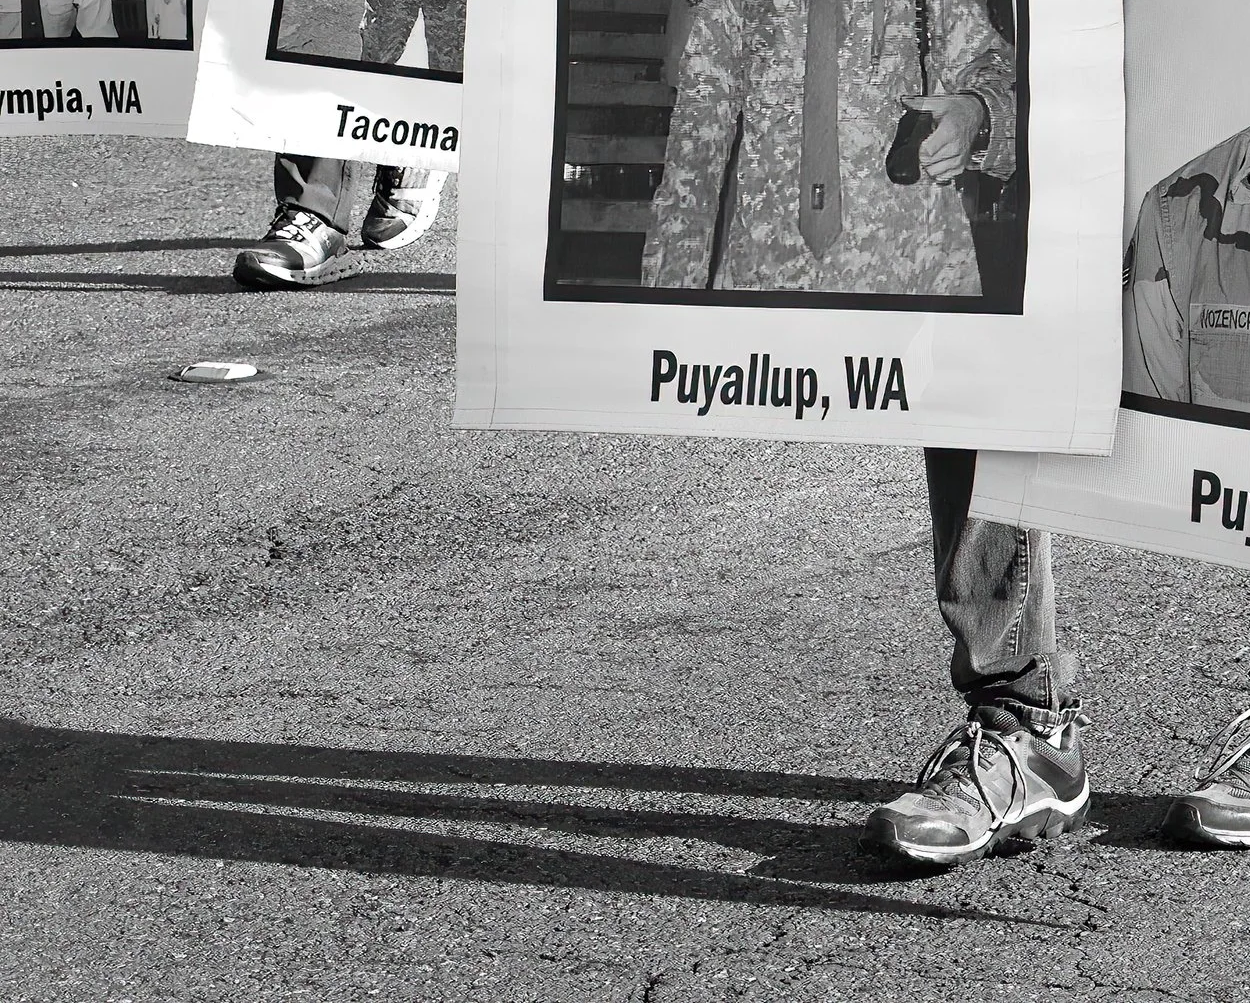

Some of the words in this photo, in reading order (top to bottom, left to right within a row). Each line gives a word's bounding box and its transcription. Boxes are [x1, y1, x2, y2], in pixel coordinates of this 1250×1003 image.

[99, 81, 142, 113] WA
[337, 105, 458, 151] Tacoma
[651, 350, 829, 420] Puyallup,
[845, 357, 909, 411] WA
